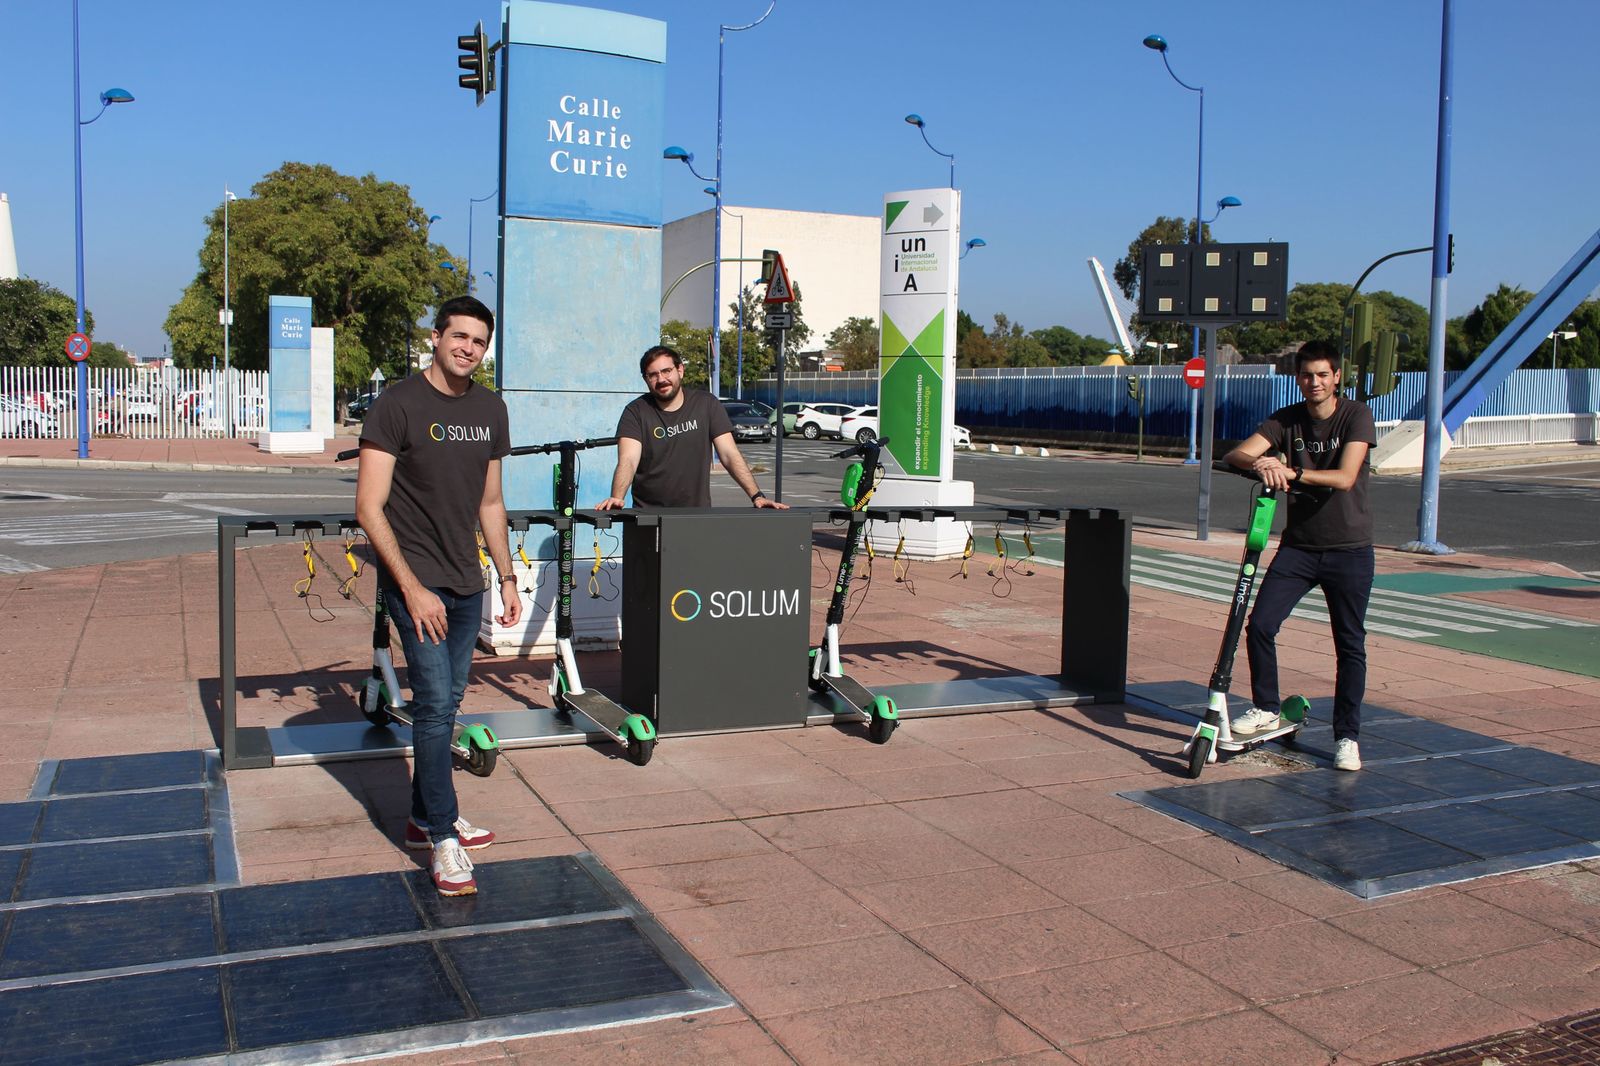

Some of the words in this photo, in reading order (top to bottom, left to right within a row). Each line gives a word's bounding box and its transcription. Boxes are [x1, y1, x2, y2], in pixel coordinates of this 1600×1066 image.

[559, 95, 622, 120] Calle
[547, 119, 632, 150] Marie
[550, 150, 628, 179] Curie
[901, 237, 926, 253] un
[901, 252, 935, 260] Universidad
[903, 273, 918, 292] A
[281, 331, 303, 339] Curie
[922, 386, 931, 429] Knowledge
[447, 424, 491, 442] SOLUM
[915, 427, 921, 435] el
[914, 436, 922, 470] expandir
[922, 430, 931, 470] expanding
[709, 588, 800, 618] SOLUM
